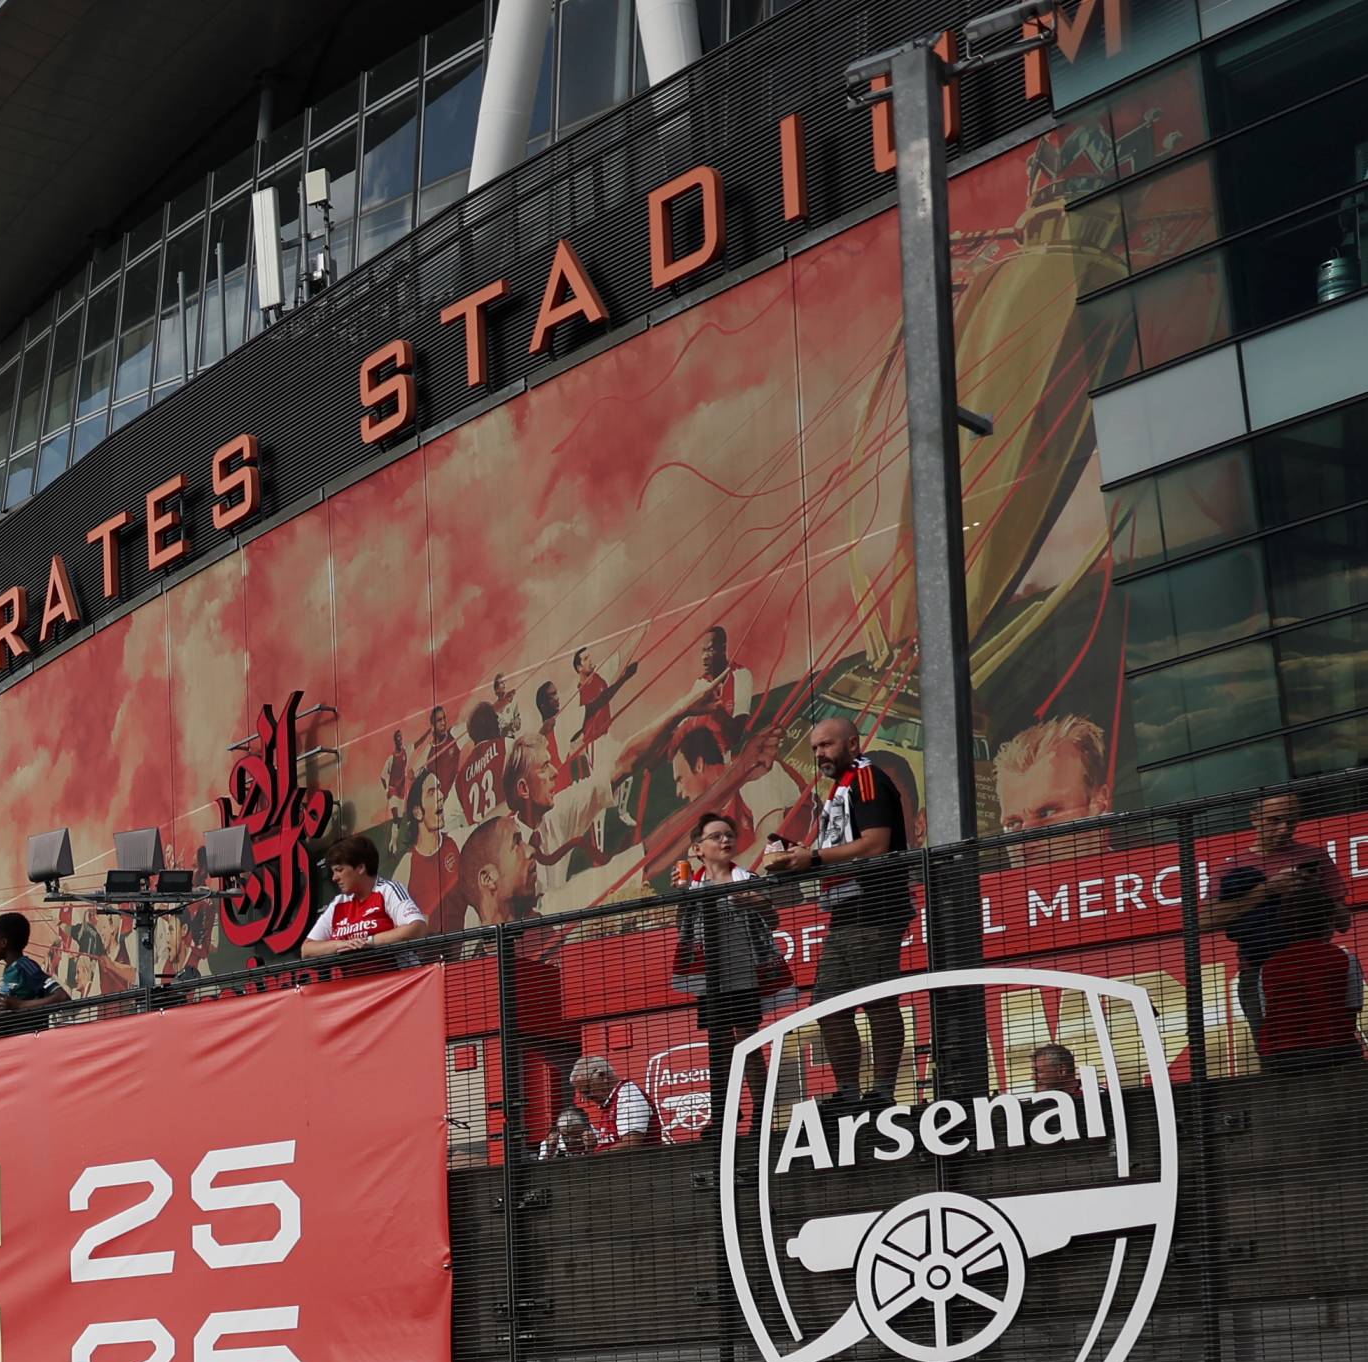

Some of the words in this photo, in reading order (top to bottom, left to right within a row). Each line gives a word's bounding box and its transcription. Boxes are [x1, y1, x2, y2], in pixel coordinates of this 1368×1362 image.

[465, 742, 499, 782] CAMPBELL
[468, 769, 497, 822] 23
[658, 1065, 711, 1089] Arsen
[774, 1065, 1107, 1174] Arsenal
[69, 1139, 302, 1284] 25
